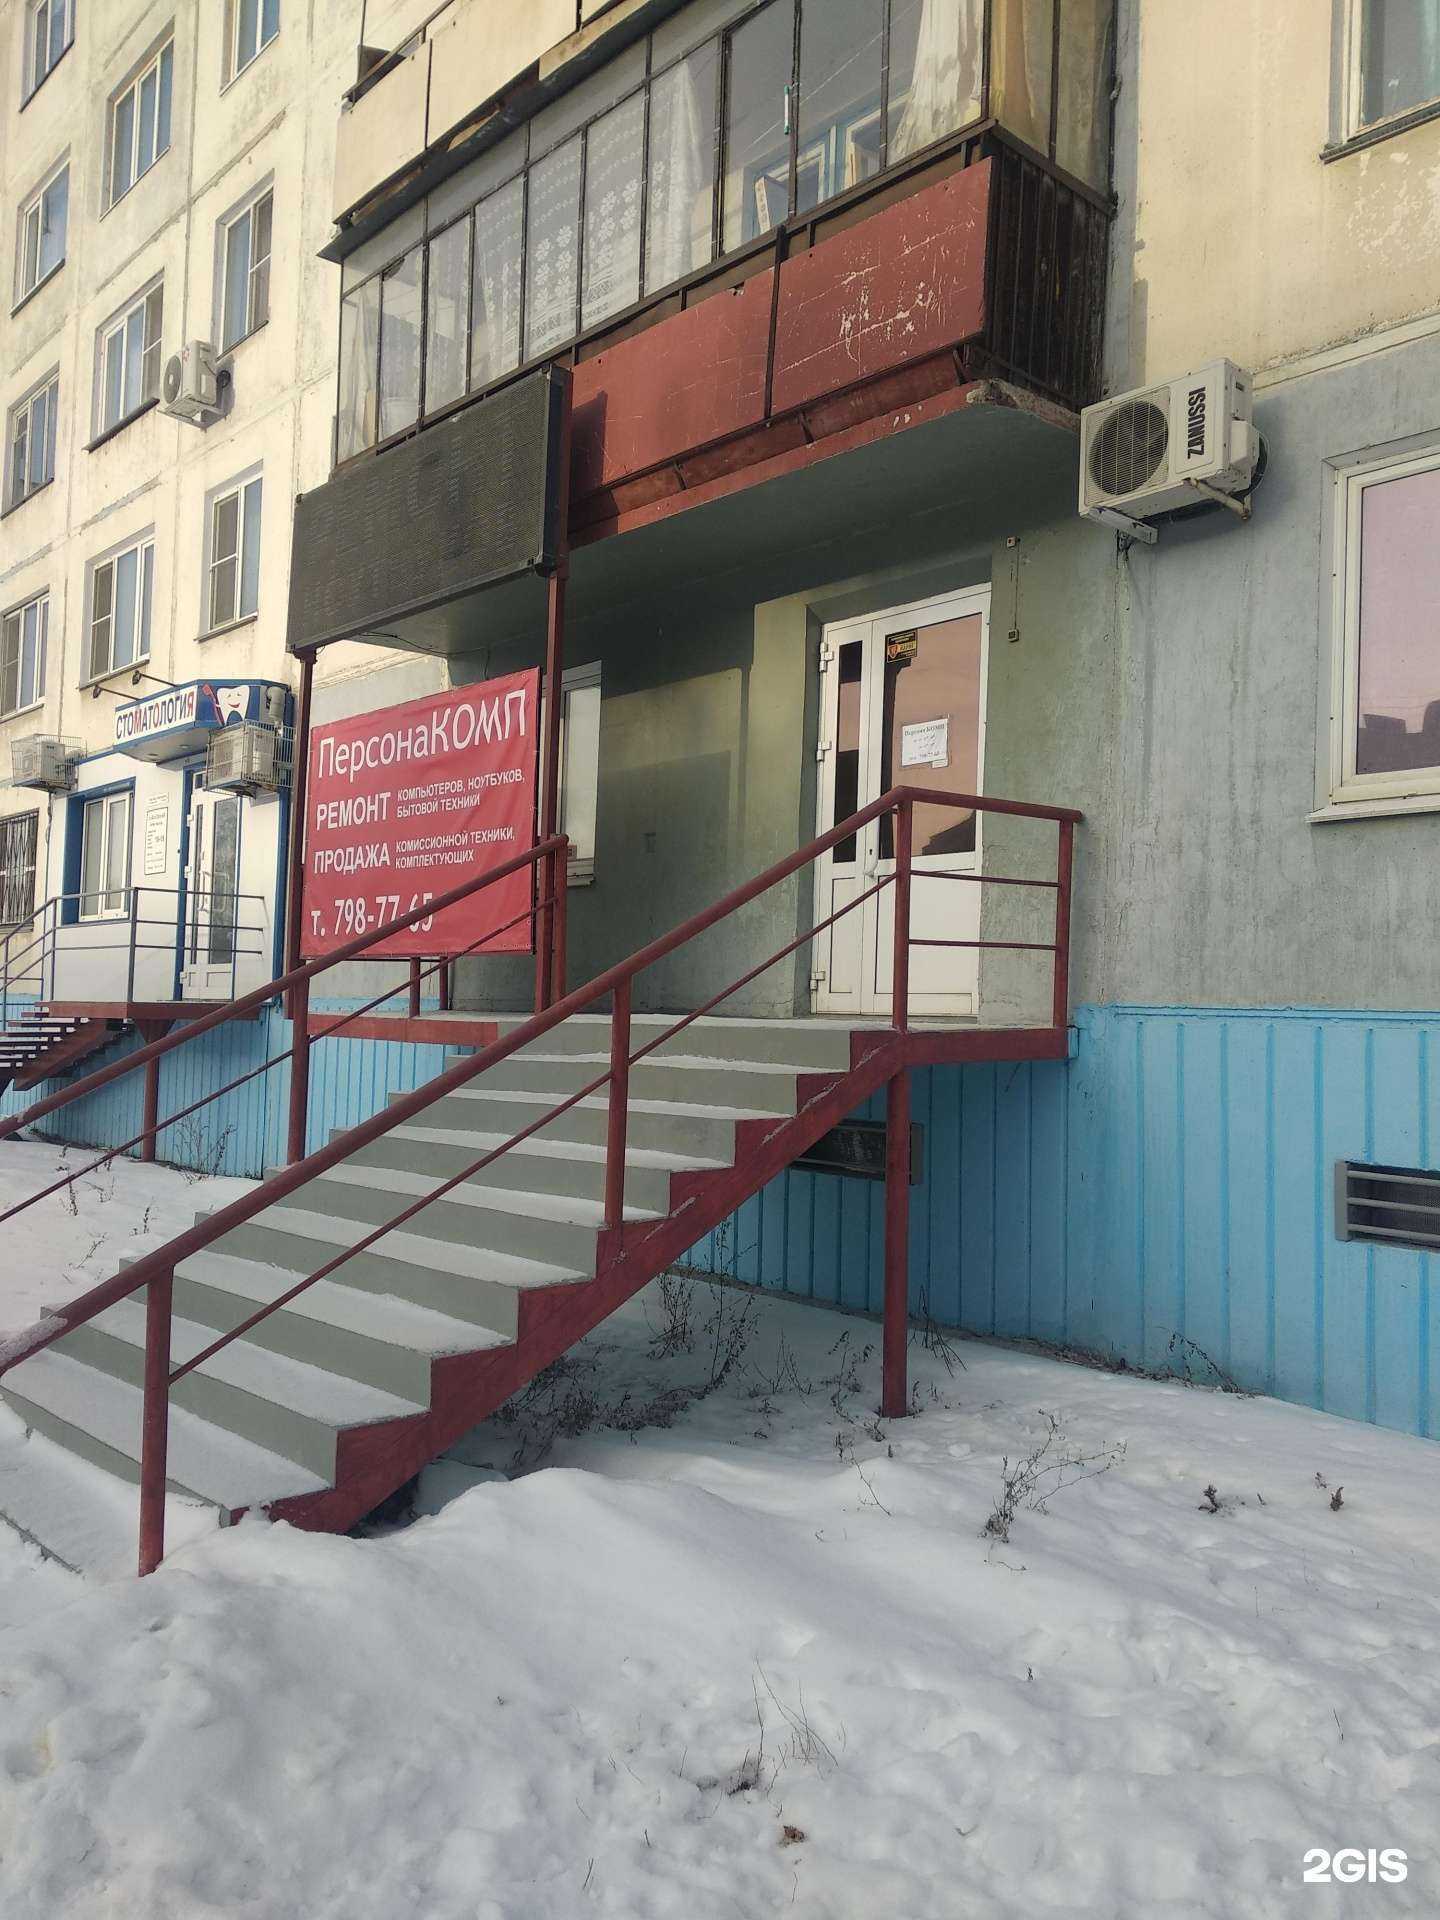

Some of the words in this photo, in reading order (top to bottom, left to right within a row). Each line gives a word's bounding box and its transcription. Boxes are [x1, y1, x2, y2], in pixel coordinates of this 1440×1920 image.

[1187, 387, 1206, 459] ZANUSSI
[116, 691, 195, 739] СТОМАТОЛОГИЯ
[318, 689, 526, 783] ПерсонаКОМП
[397, 780, 465, 801] КОМПЬЮТЕРОВ,
[468, 769, 525, 790] НОУТБУКОВ,
[316, 792, 391, 831] РЕМОНТ
[397, 797, 439, 818] БЫТОВОЙ
[441, 794, 480, 811] ТЕХНИКИ
[396, 830, 468, 853] КОМИССИОННОЙ
[470, 827, 515, 844] ТЕХНИКИ,
[314, 842, 391, 875] ПРОДАЖА
[395, 849, 474, 869] КОМПЛЕКТУЮЩИХ
[311, 910, 326, 937] т.
